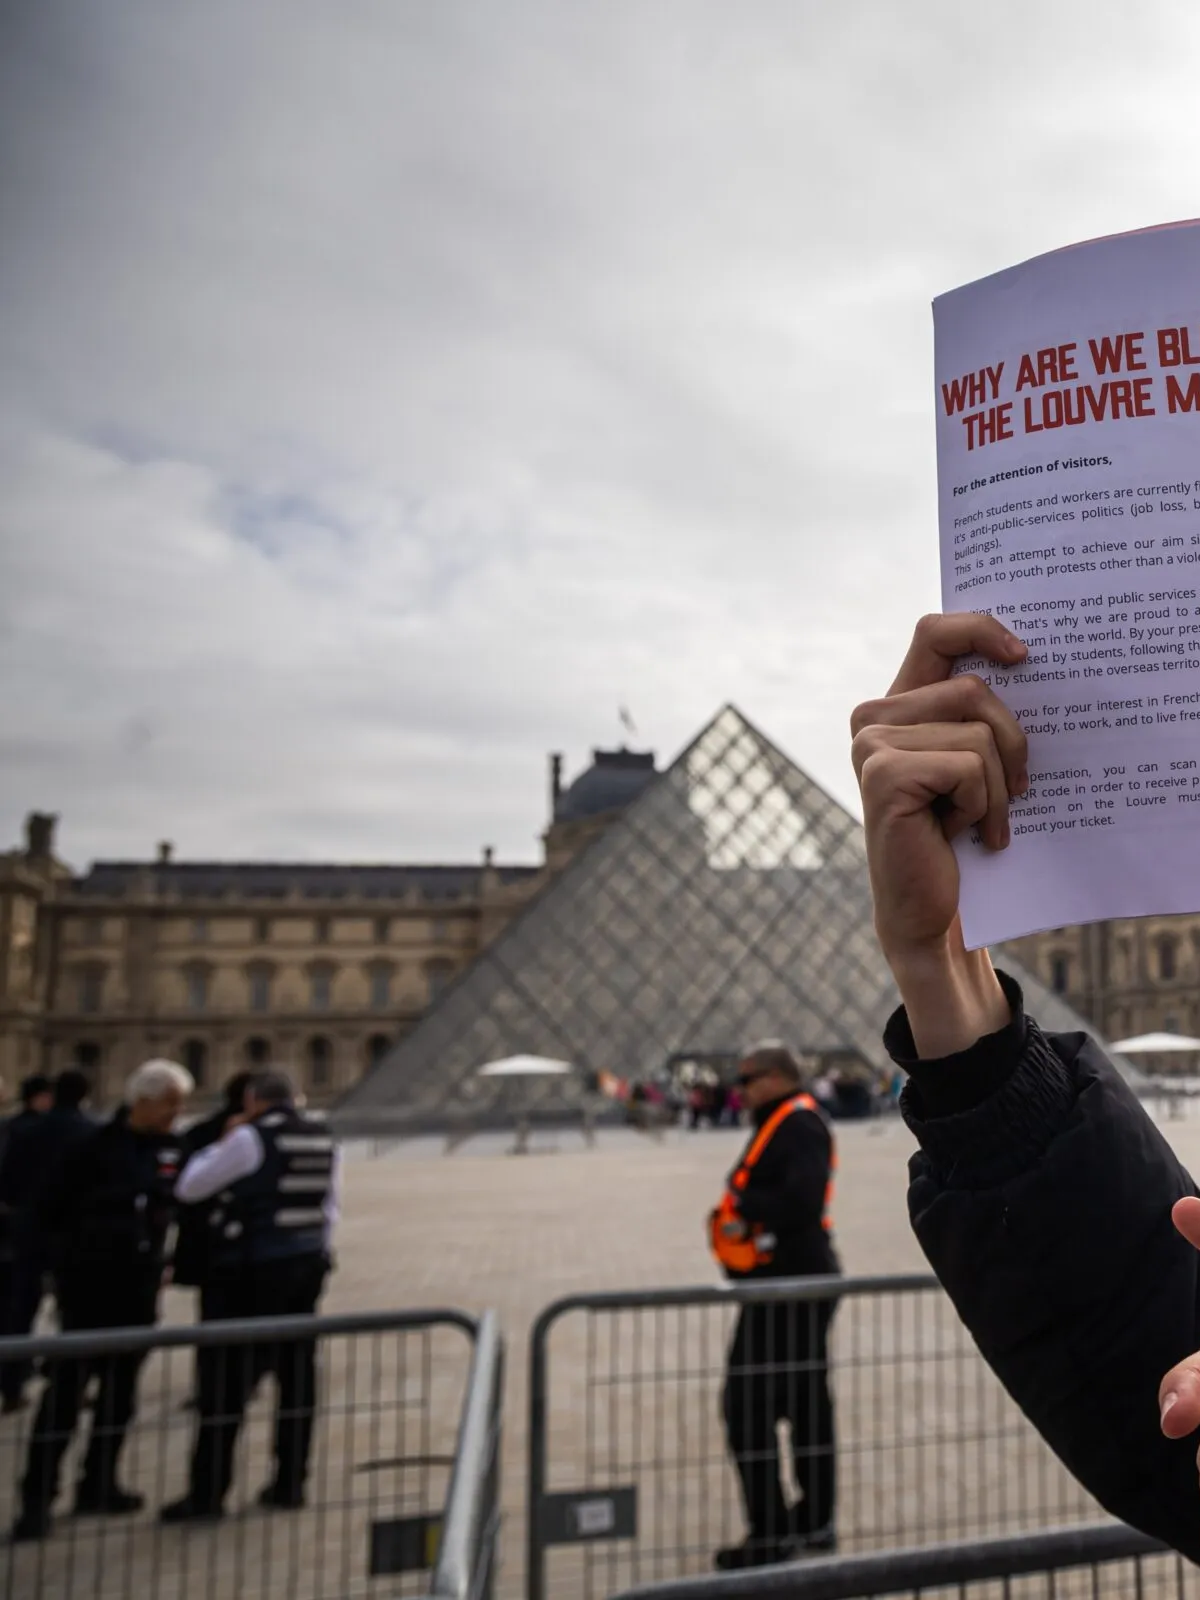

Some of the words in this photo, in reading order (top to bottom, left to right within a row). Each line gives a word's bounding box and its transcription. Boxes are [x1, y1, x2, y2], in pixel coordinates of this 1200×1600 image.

[941, 361, 1005, 417] WHY
[1015, 342, 1079, 393] ARE
[1088, 332, 1147, 376] WE
[962, 401, 1014, 451] THE
[1024, 377, 1156, 434] LOUVRE
[953, 484, 969, 497] For
[970, 478, 987, 491] the
[989, 465, 1043, 484] attention
[1046, 459, 1060, 472] of
[1061, 456, 1112, 470] visitors,
[954, 509, 984, 529] French
[986, 500, 1033, 518] students
[1036, 494, 1058, 508] and
[1061, 490, 1111, 504] workers
[1113, 488, 1134, 499] are
[1136, 482, 1191, 497] currently
[954, 533, 966, 545] it's
[969, 511, 1076, 539] anti-public-services
[1081, 505, 1124, 522] politics
[1130, 501, 1154, 518] (job
[1160, 500, 1187, 512] loss,
[954, 537, 1002, 561] buildings).
[954, 563, 972, 576] This
[975, 558, 984, 569] is
[989, 555, 1003, 566] an
[1009, 547, 1057, 562] attempt
[1062, 546, 1076, 557] to
[1081, 541, 1128, 554] achieve
[1134, 539, 1155, 550] our
[1161, 536, 1184, 548] aim
[955, 574, 992, 593] reaction
[994, 572, 1007, 582] to
[1009, 564, 1044, 582] youth
[1046, 561, 1097, 578] protests
[1099, 557, 1133, 570] other
[1135, 555, 1163, 567] than
[1166, 555, 1174, 565] a
[996, 604, 1016, 615] the
[1020, 599, 1076, 613] economy
[1080, 594, 1104, 608] and
[1107, 591, 1145, 608] public
[1148, 588, 1197, 602] services
[1011, 617, 1049, 631] That's
[1053, 614, 1079, 629] why
[1084, 614, 1102, 625] we
[1108, 612, 1128, 623] are
[1133, 606, 1171, 624] proud
[1176, 607, 1189, 617] to
[1049, 634, 1061, 646] in
[1064, 632, 1085, 644] the
[1087, 627, 1125, 641] world.
[1129, 627, 1145, 641] By
[1146, 626, 1175, 641] your
[1052, 651, 1068, 665] by
[1070, 648, 1127, 661] students,
[1129, 642, 1185, 656] following
[995, 674, 1010, 688] by
[1013, 670, 1066, 684] students
[1068, 667, 1080, 679] in
[1083, 665, 1103, 678] the
[1106, 662, 1160, 676] overseas
[1015, 708, 1038, 721] you
[1042, 705, 1060, 716] for
[1064, 703, 1092, 718] your
[1097, 698, 1144, 712] interest
[1147, 696, 1159, 707] in
[1024, 721, 1060, 735] study,
[1063, 721, 1076, 731] to
[1078, 716, 1112, 730] work,
[1115, 714, 1138, 727] and
[1140, 715, 1154, 725] to
[1156, 712, 1177, 723] live
[1030, 768, 1092, 784] pensation,
[1103, 766, 1126, 779] you
[1137, 763, 1158, 773] can
[1170, 760, 1197, 770] scan
[1041, 785, 1070, 798] code
[1075, 784, 1086, 795] in
[1091, 781, 1124, 793] order
[1128, 781, 1141, 791] to
[1145, 776, 1187, 789] receive
[1010, 804, 1056, 818] rmation
[1067, 802, 1083, 812] on
[1094, 798, 1114, 810] the
[1126, 795, 1167, 807] Louvre
[1014, 822, 1048, 836] about
[1049, 819, 1077, 833] your
[1079, 815, 1115, 827] ticket.
